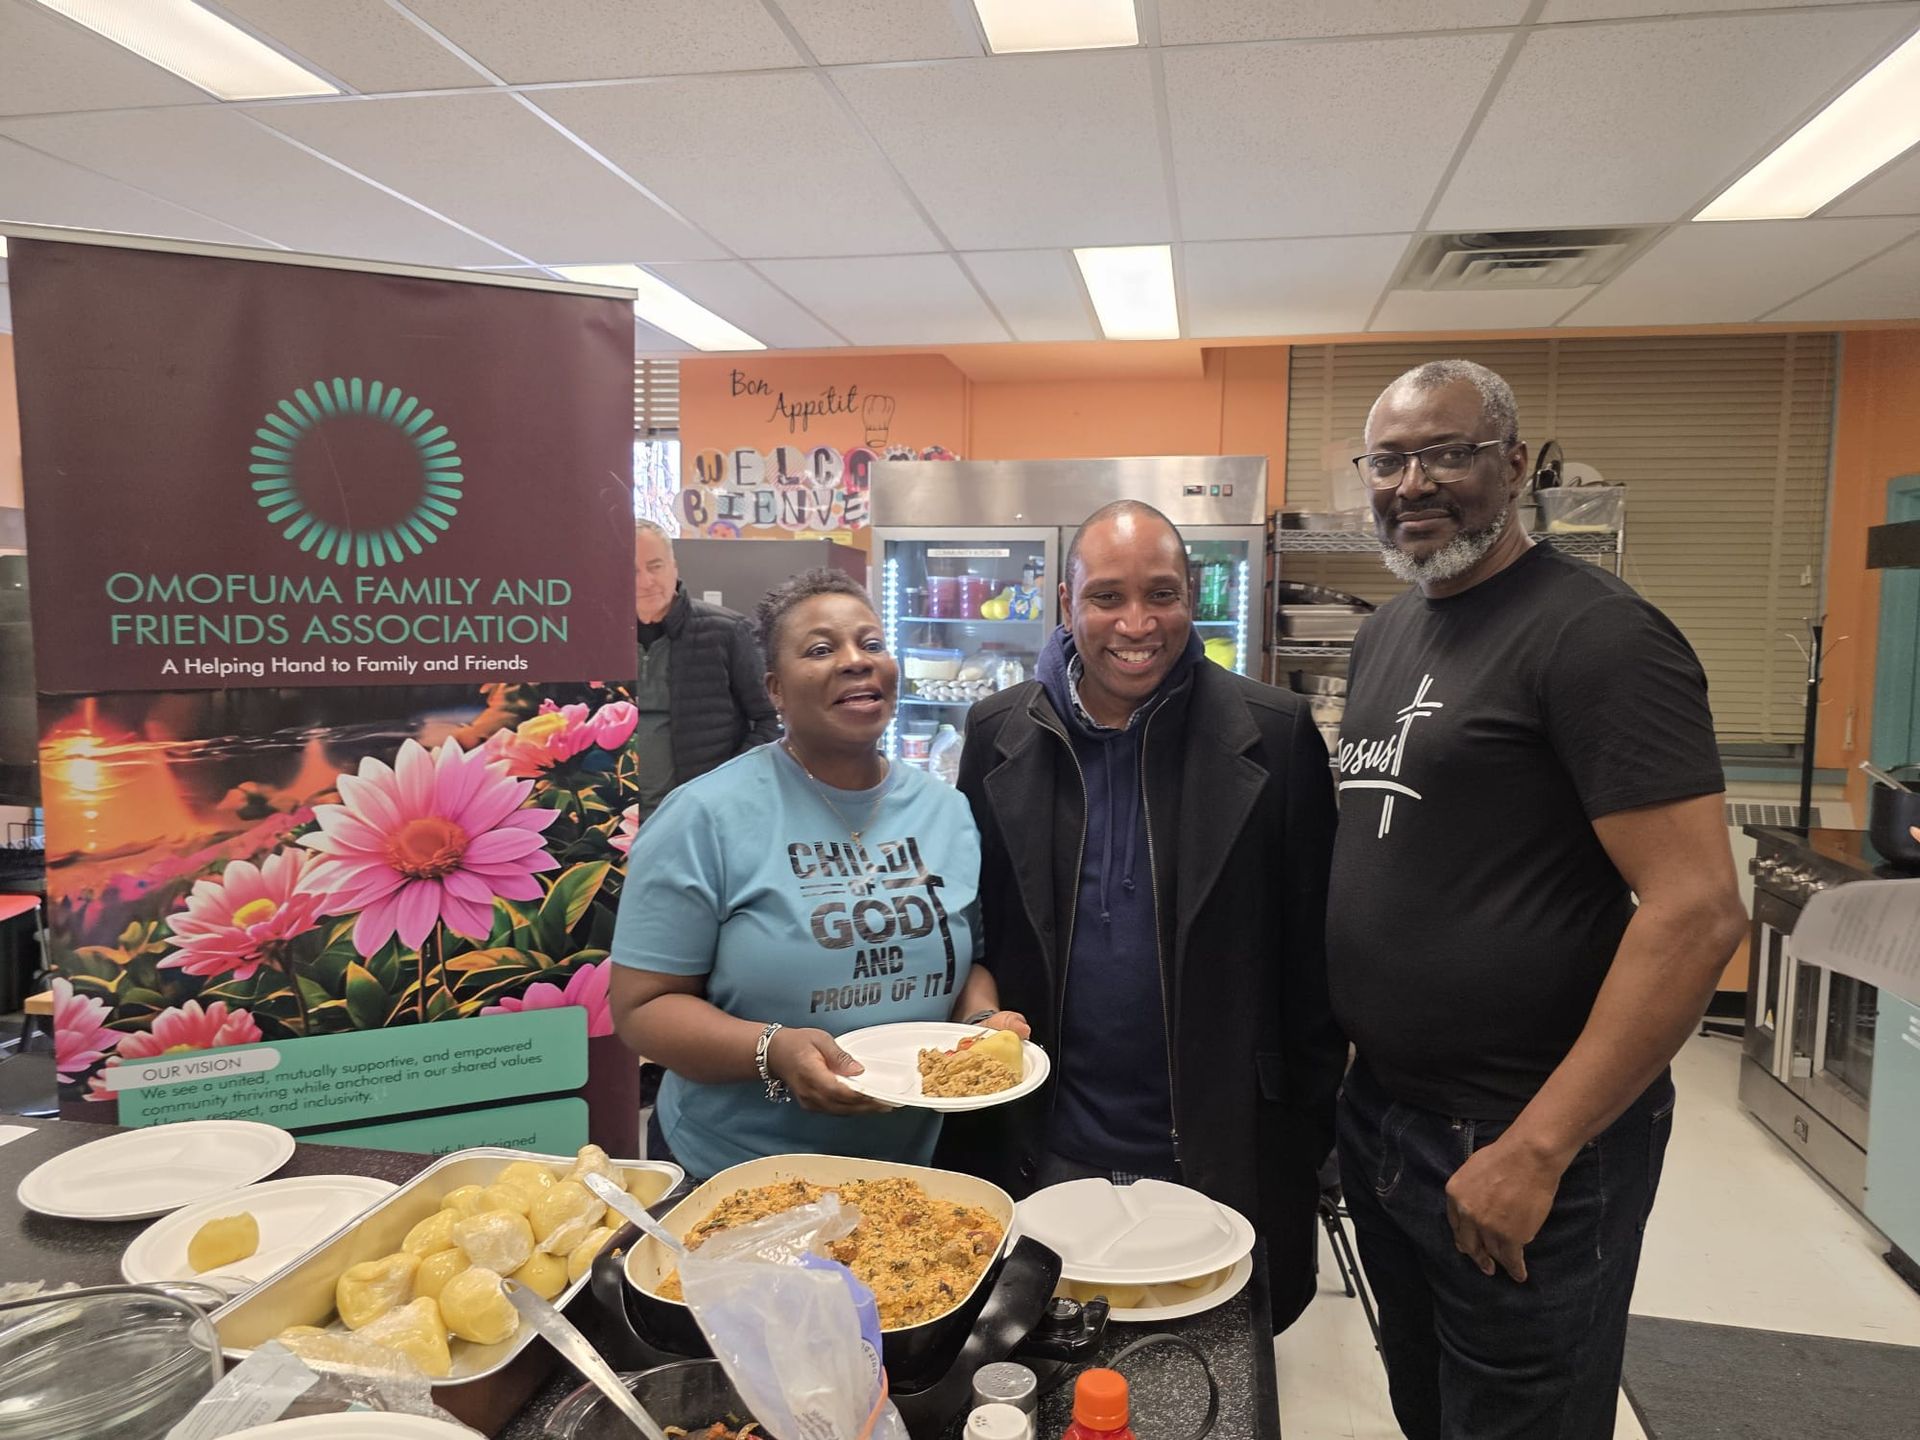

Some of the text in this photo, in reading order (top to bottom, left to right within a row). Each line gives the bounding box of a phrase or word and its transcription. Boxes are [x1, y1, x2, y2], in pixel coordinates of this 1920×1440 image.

[730, 369, 774, 396] Bon
[106, 572, 572, 606] OMOFUMA FAMILY AND
[111, 614, 568, 644] FRIENDS ASSOCIATION
[161, 654, 529, 677] A Helping Hand to Family and Friends
[787, 839, 909, 878] CHILD
[810, 895, 934, 950] GOD
[853, 946, 904, 979] AND
[810, 973, 943, 1013] PROUD OF IT
[141, 1038, 532, 1100] We see a united, mutually supportive, and empowered
[142, 1053, 543, 1117] community thriving while anchored in our shared values
[143, 1057, 242, 1081] OUR VISION
[269, 1100, 298, 1113] and
